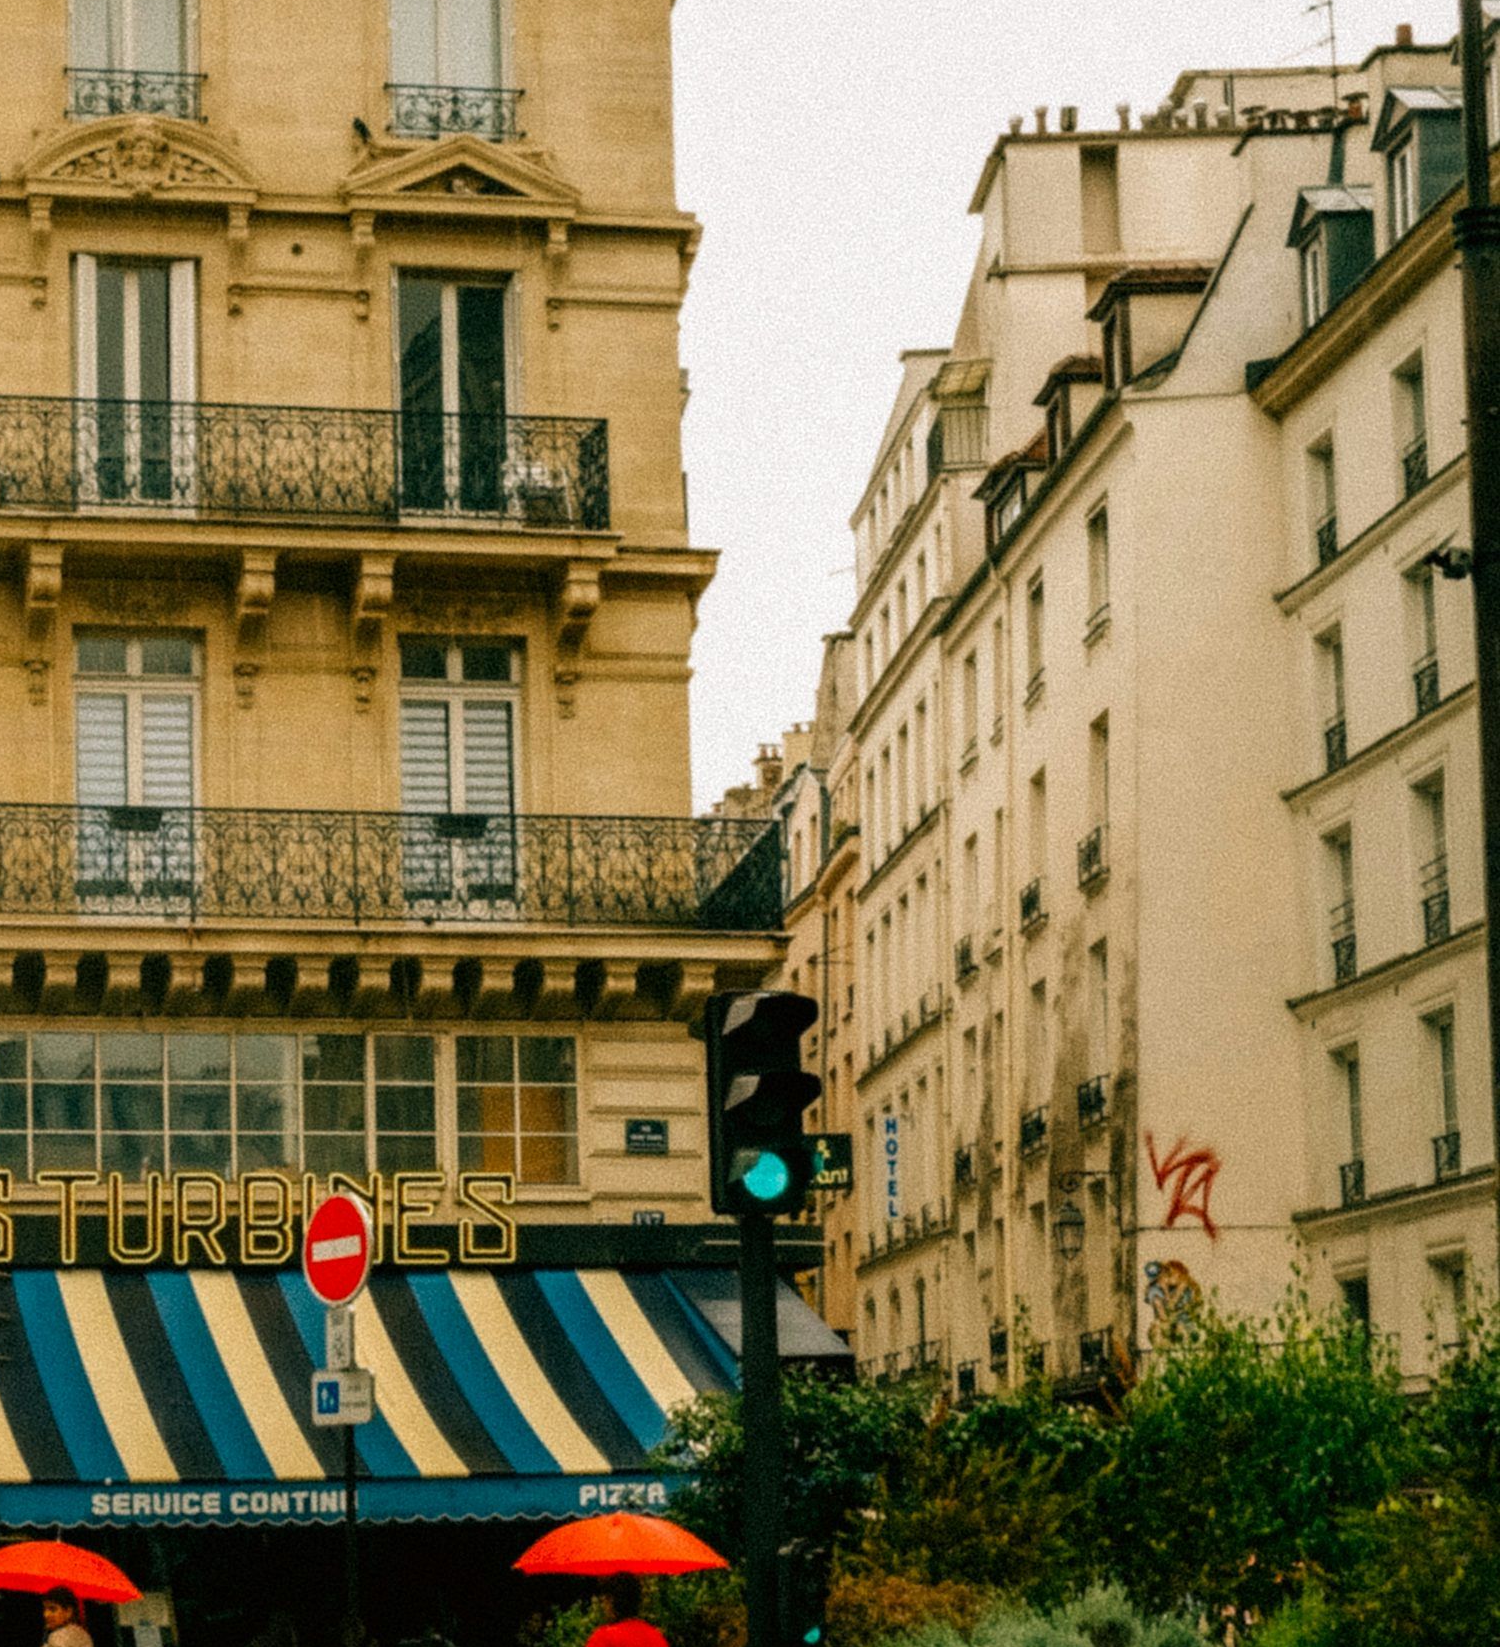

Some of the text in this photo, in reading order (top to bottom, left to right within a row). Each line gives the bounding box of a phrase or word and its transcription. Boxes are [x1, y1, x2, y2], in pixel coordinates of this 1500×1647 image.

[885, 1118, 899, 1218] HOTEL
[36, 1169, 517, 1266] TURBINES
[90, 1491, 222, 1516] SERVICE
[579, 1481, 668, 1507] PIZZA
